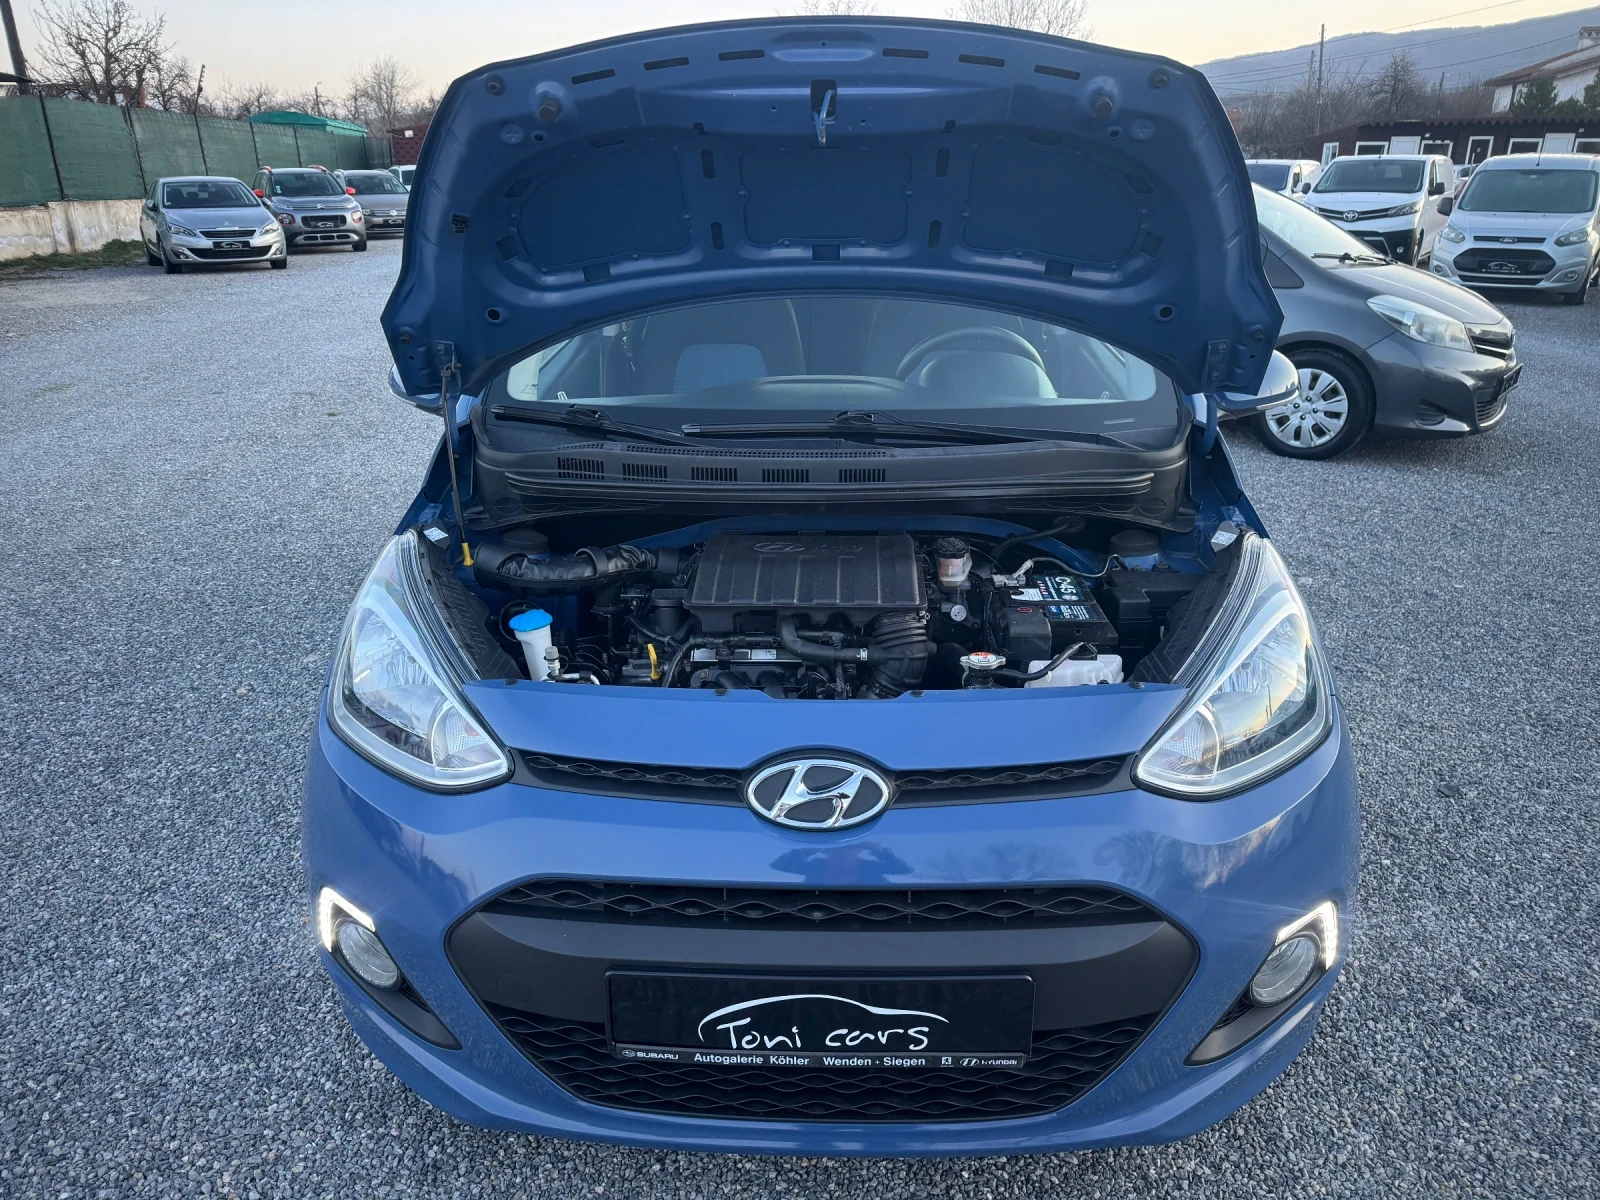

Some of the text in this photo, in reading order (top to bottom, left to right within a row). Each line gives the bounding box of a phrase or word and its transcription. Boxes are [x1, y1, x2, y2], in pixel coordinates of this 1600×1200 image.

[716, 1016, 930, 1050] Toni cars
[636, 1051, 679, 1060] SUBARU
[694, 1052, 764, 1066] Autogalerie
[769, 1054, 810, 1065] Köhler
[823, 1056, 872, 1067] Wenden
[883, 1056, 926, 1068] Siegen
